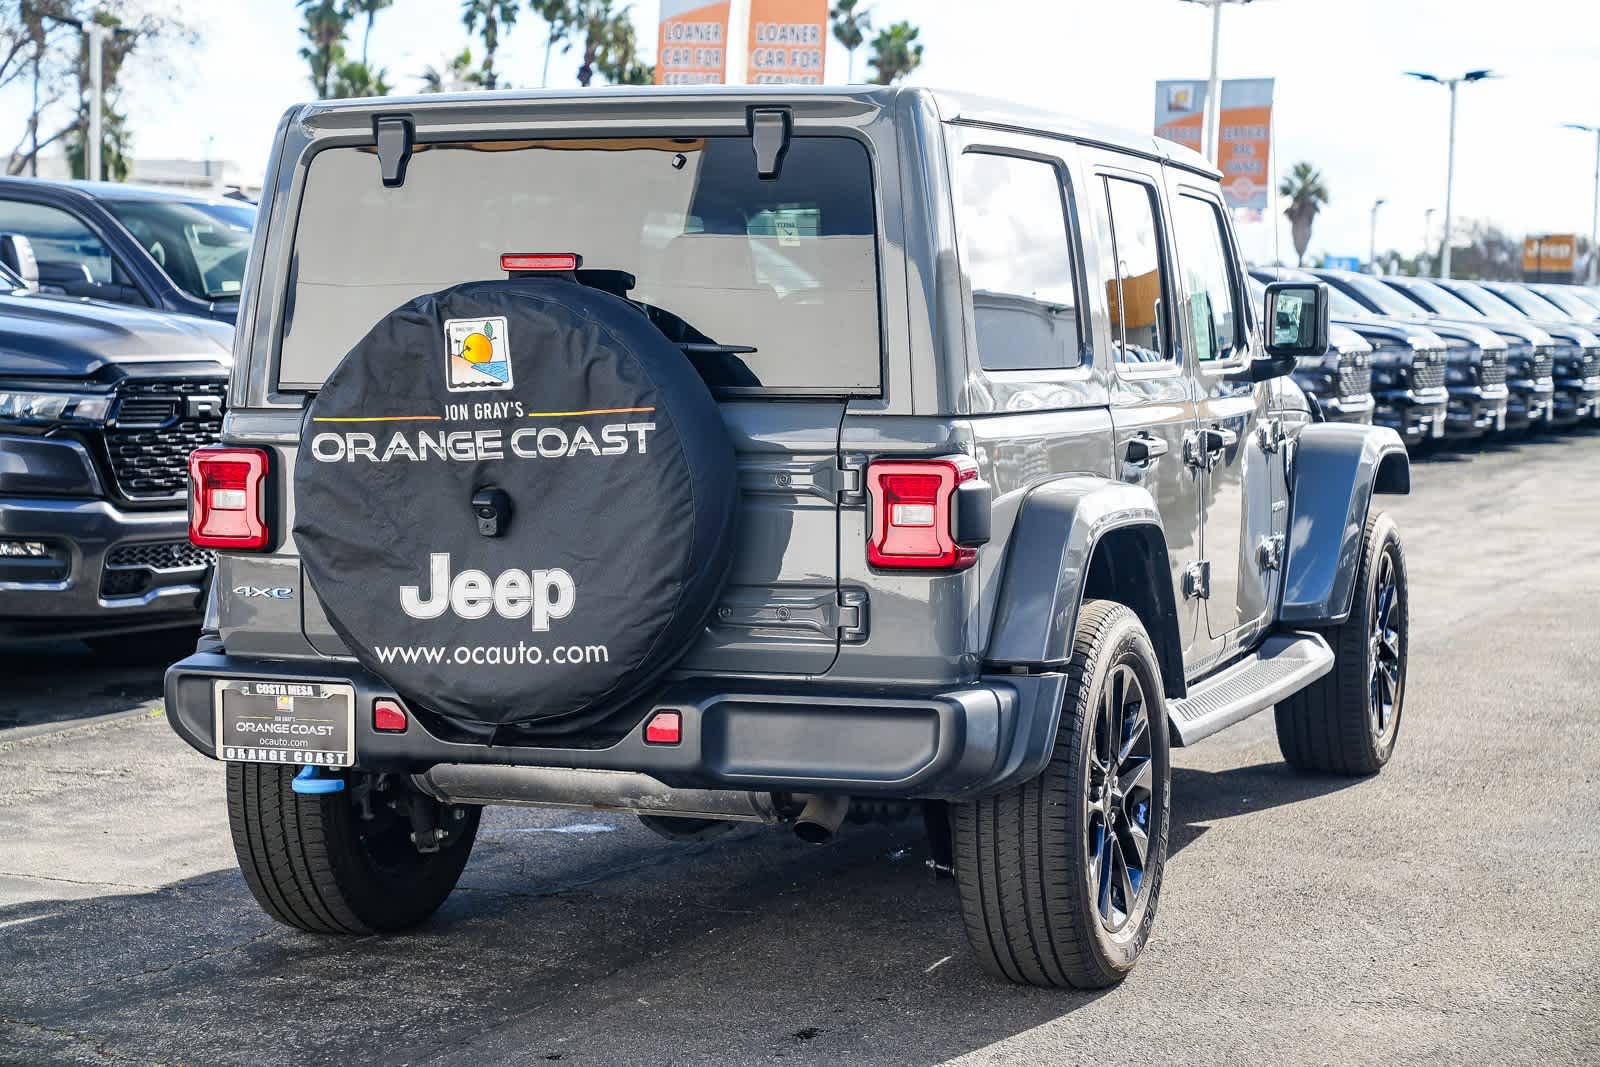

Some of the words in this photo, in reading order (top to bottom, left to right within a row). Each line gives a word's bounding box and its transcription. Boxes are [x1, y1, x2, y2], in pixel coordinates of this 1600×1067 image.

[665, 23, 721, 41] LOANER
[757, 24, 820, 41] LOANER
[663, 49, 691, 66] CAR
[696, 49, 721, 66] FOR
[754, 50, 786, 67] CAR
[792, 50, 820, 67] FOR
[445, 404, 470, 421] JON
[474, 401, 524, 420] GRAY'S
[312, 429, 504, 463] ORANGE
[511, 423, 656, 458] COAST
[233, 586, 293, 600] 4xe
[399, 552, 577, 632] Jeep
[375, 641, 609, 665] www.ocauto.com
[256, 683, 287, 695] COSTA
[288, 684, 314, 696] MESA
[235, 721, 290, 734] ORANGE
[290, 724, 335, 736] COAST
[259, 737, 309, 748] ocauto.com
[226, 747, 288, 762] ORANGE
[293, 752, 345, 764] COAST
